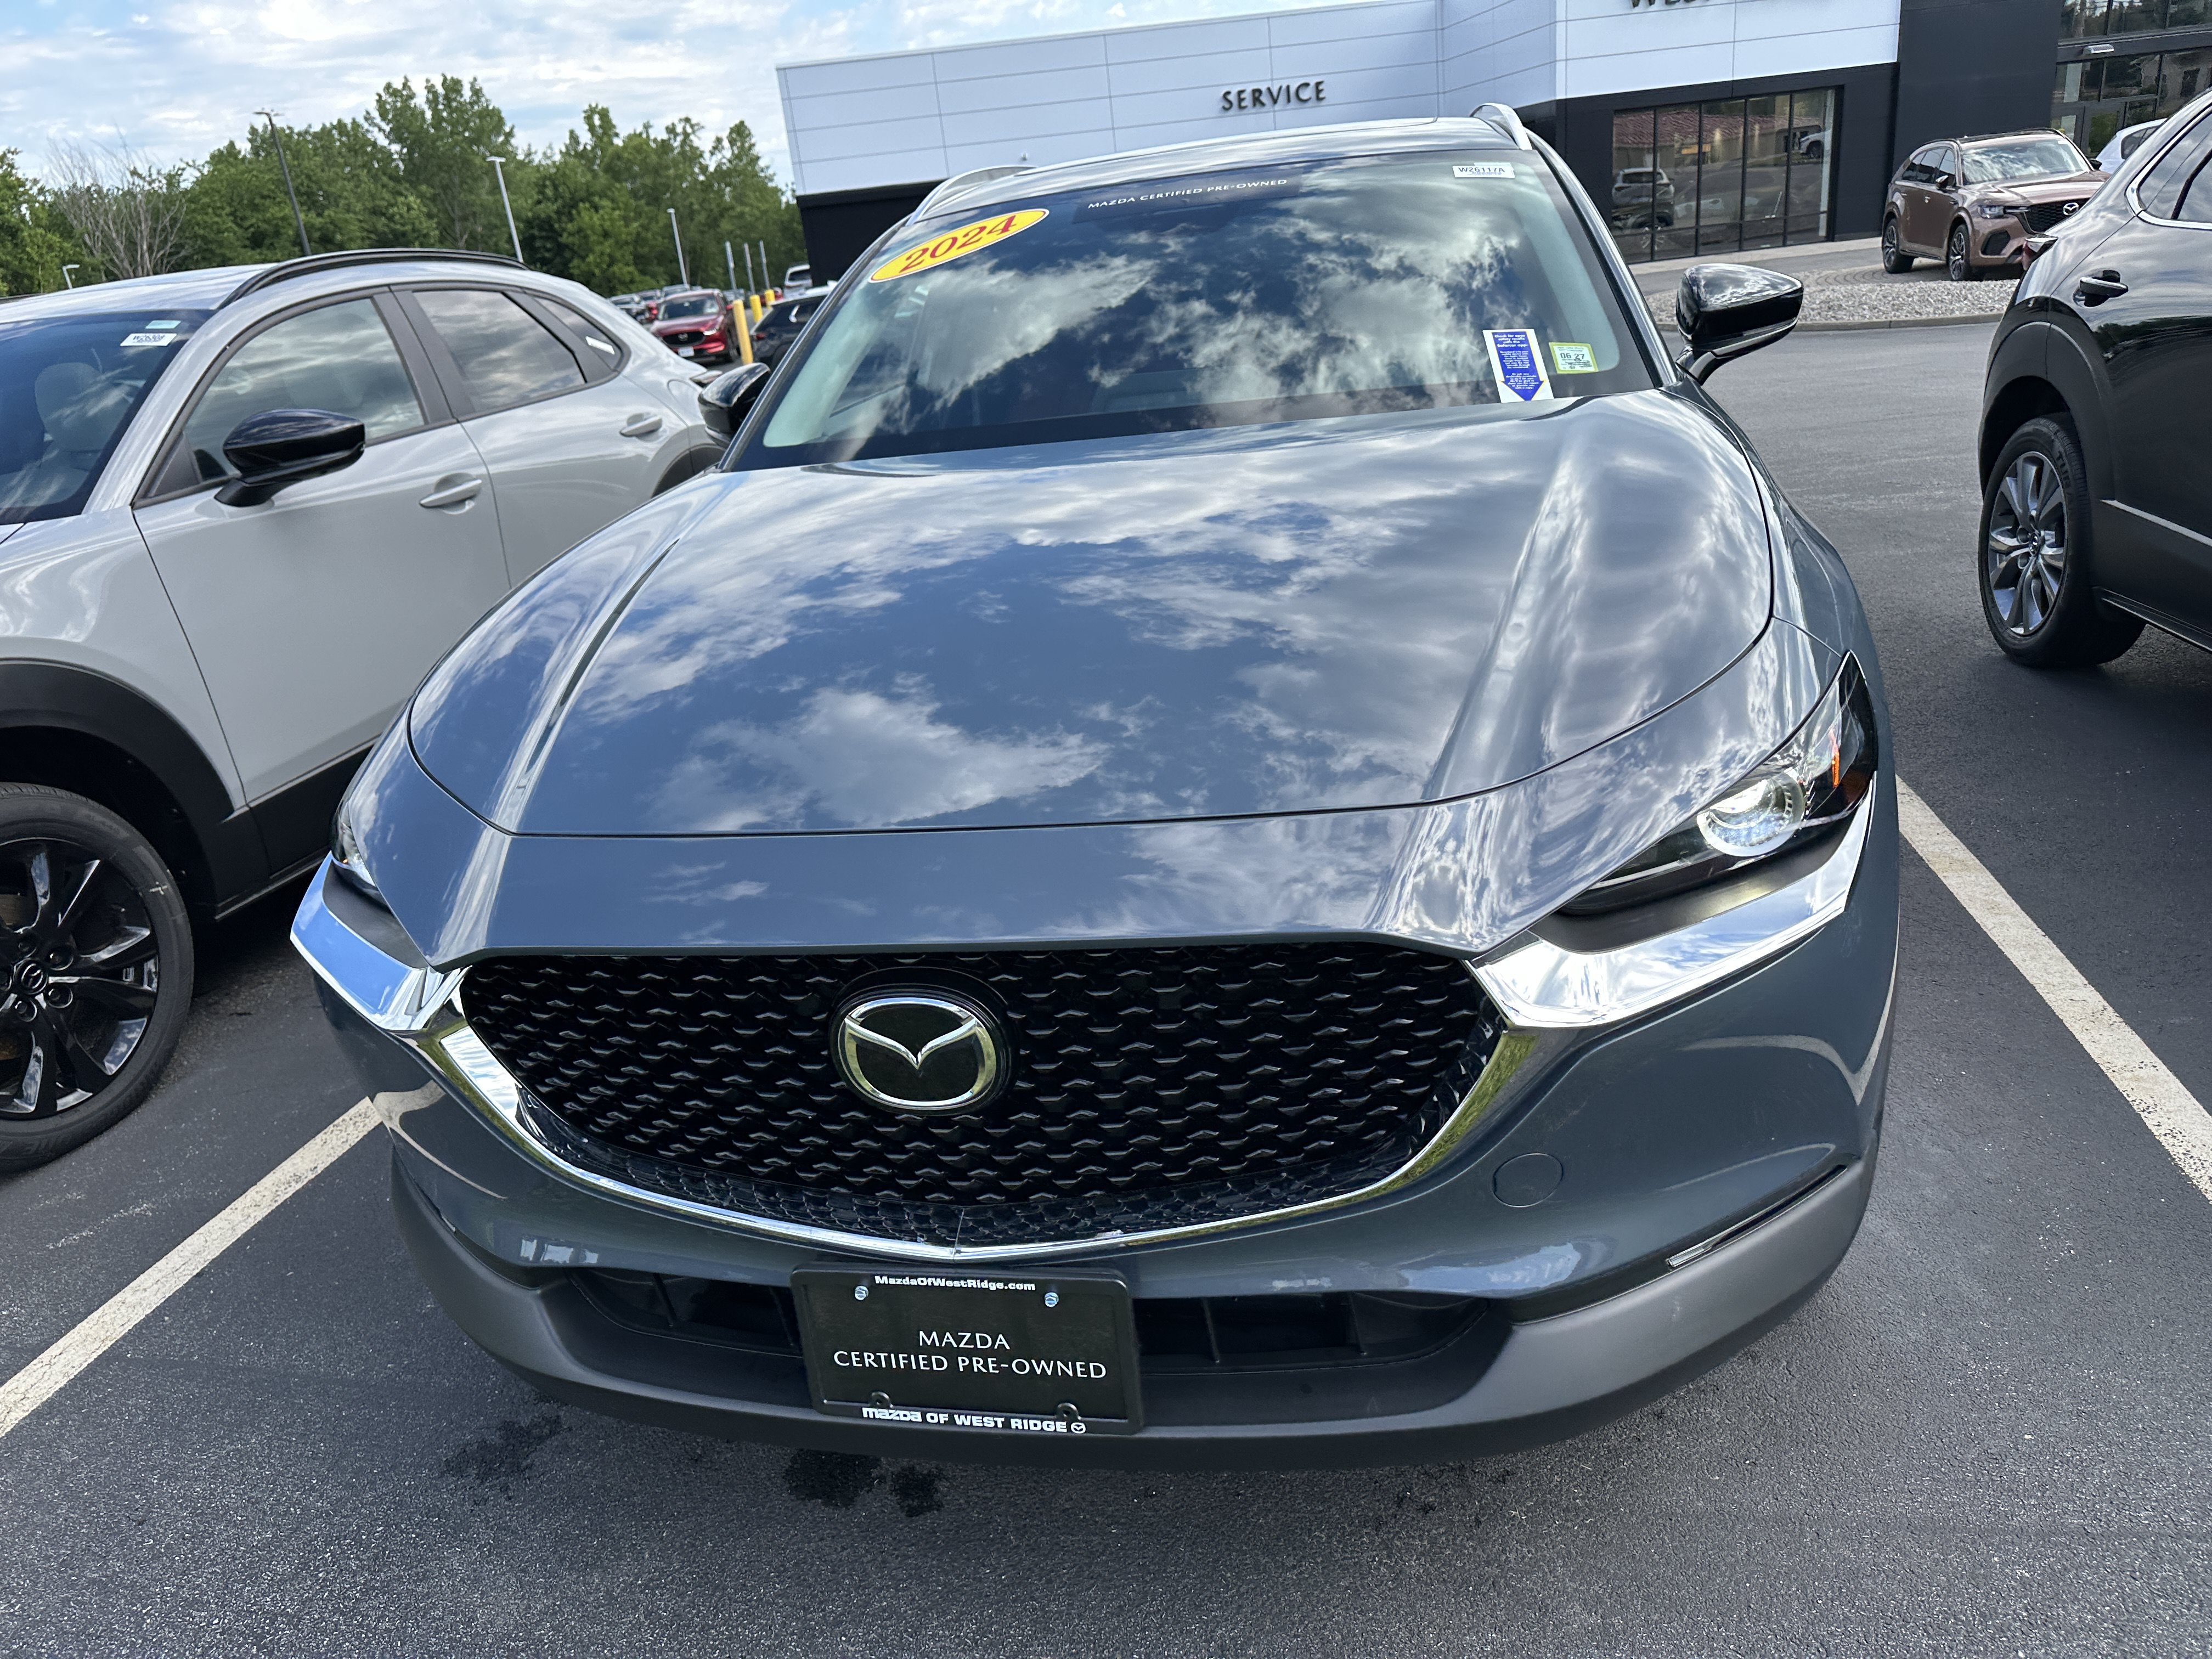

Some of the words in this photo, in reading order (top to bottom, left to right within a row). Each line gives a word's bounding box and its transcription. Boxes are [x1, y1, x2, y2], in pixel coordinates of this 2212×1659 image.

[1221, 80, 1326, 110] SERVICE
[1087, 197, 1136, 209] MAZDA
[1139, 188, 1203, 201] CERTIFIED
[1207, 179, 1287, 192] PRE-OWNED
[899, 215, 1017, 273] 2024
[874, 1276, 1036, 1291] MazdaOfWestRidge.com
[919, 1330, 1011, 1350] MAZDA
[833, 1351, 949, 1372] CERTIFIED
[958, 1357, 1107, 1379] PRE-OWNED
[926, 1413, 949, 1425] OF
[953, 1414, 1005, 1429] WEST
[1011, 1418, 1068, 1433] RIDGE
